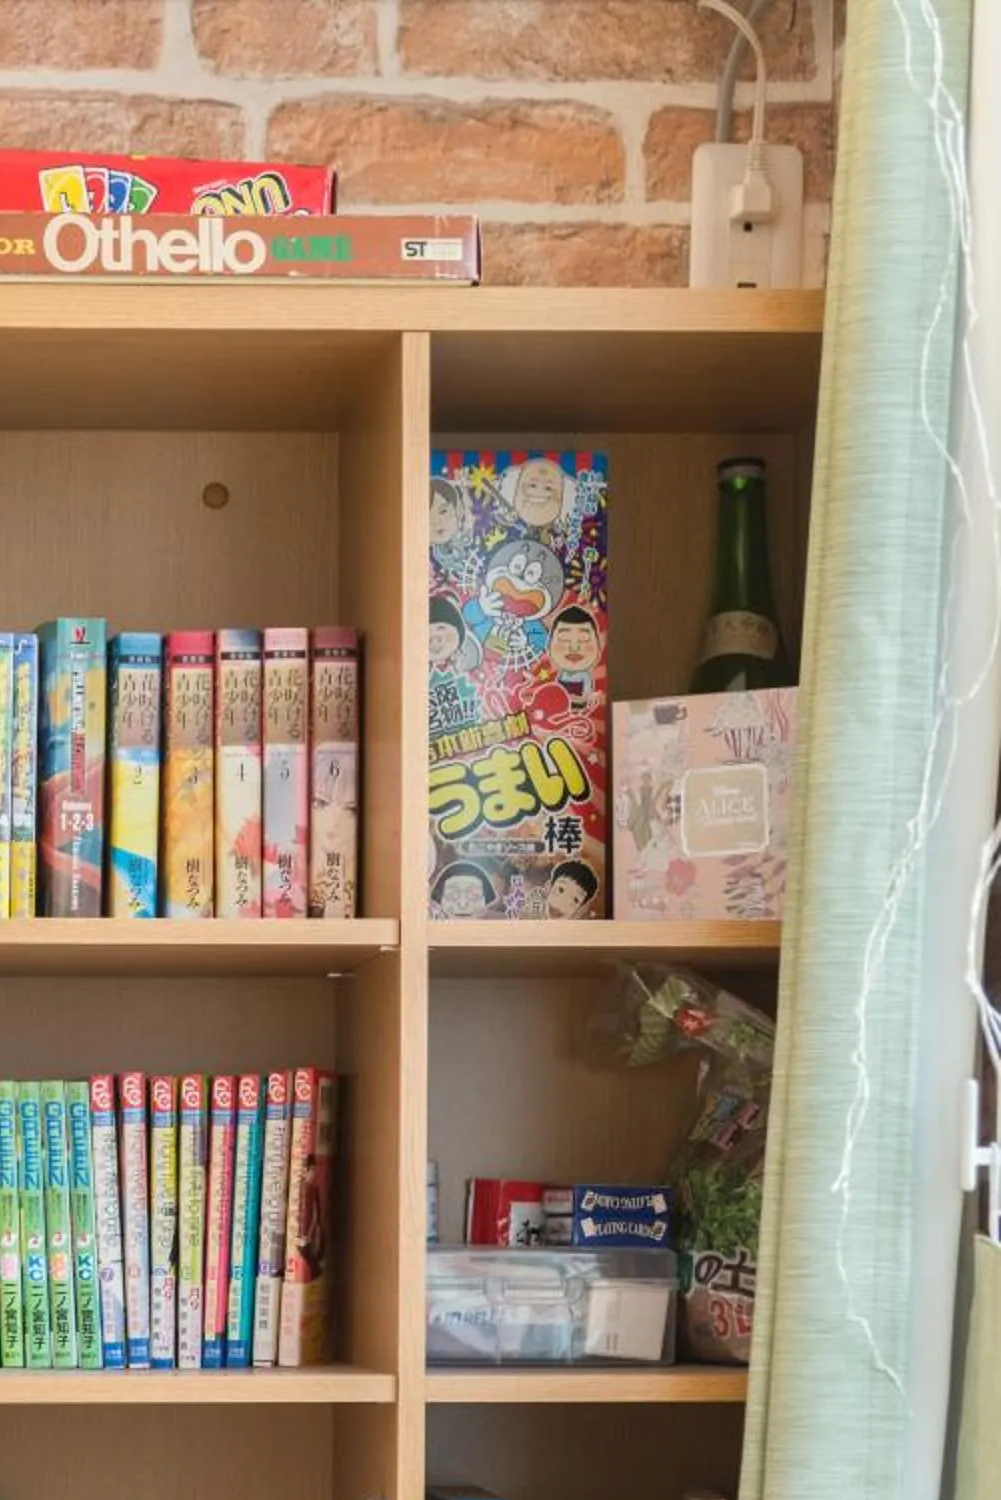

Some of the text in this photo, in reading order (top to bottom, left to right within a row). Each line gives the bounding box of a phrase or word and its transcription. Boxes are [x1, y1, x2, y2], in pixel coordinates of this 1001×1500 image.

[43, 212, 266, 273] Othello
[429, 738, 589, 854] うまい 棒
[20, 1102, 40, 1190] GREEN
[46, 1101, 65, 1187] GREEN
[70, 1102, 90, 1187] GREEN
[28, 1255, 44, 1281] KC
[77, 1254, 92, 1281] KC
